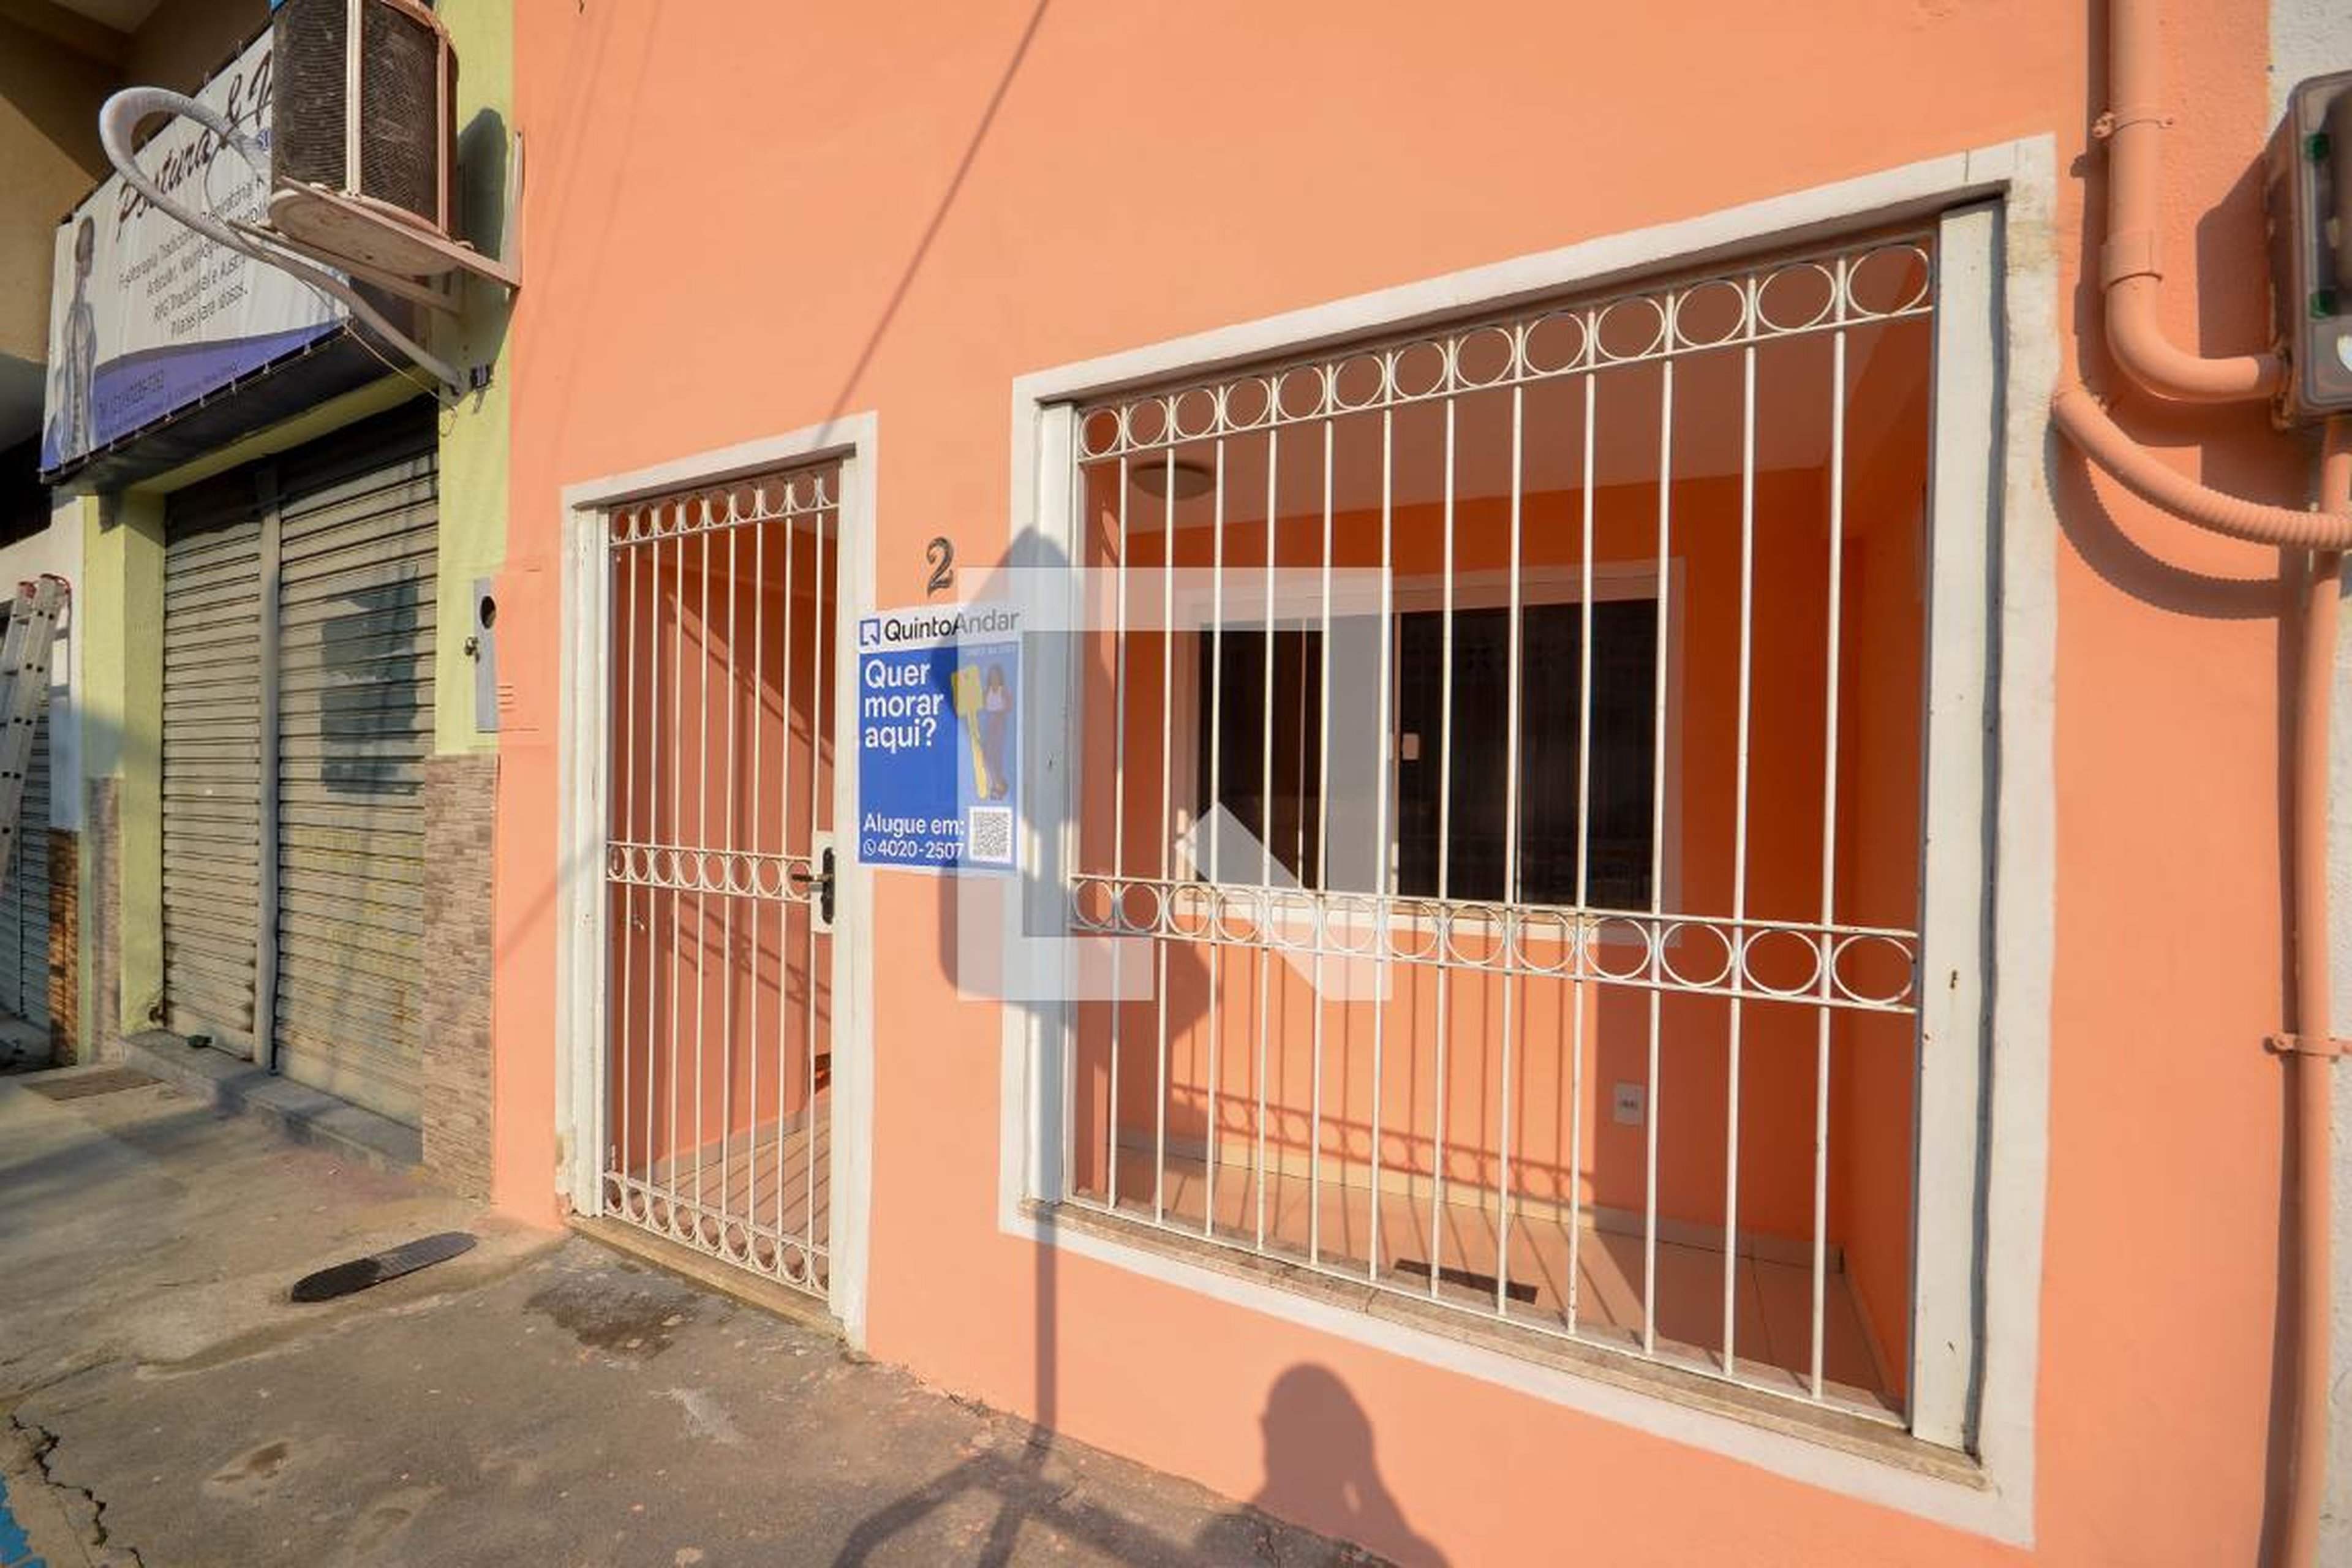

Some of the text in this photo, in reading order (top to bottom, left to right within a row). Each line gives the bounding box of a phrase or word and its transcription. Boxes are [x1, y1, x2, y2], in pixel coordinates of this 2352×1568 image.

[926, 537, 954, 597] 2
[884, 609, 1020, 642] QuintoAndar
[865, 659, 930, 689] Quer
[864, 693, 944, 718] morar
[864, 717, 937, 754] aqui?
[863, 813, 965, 838] Alugue em:
